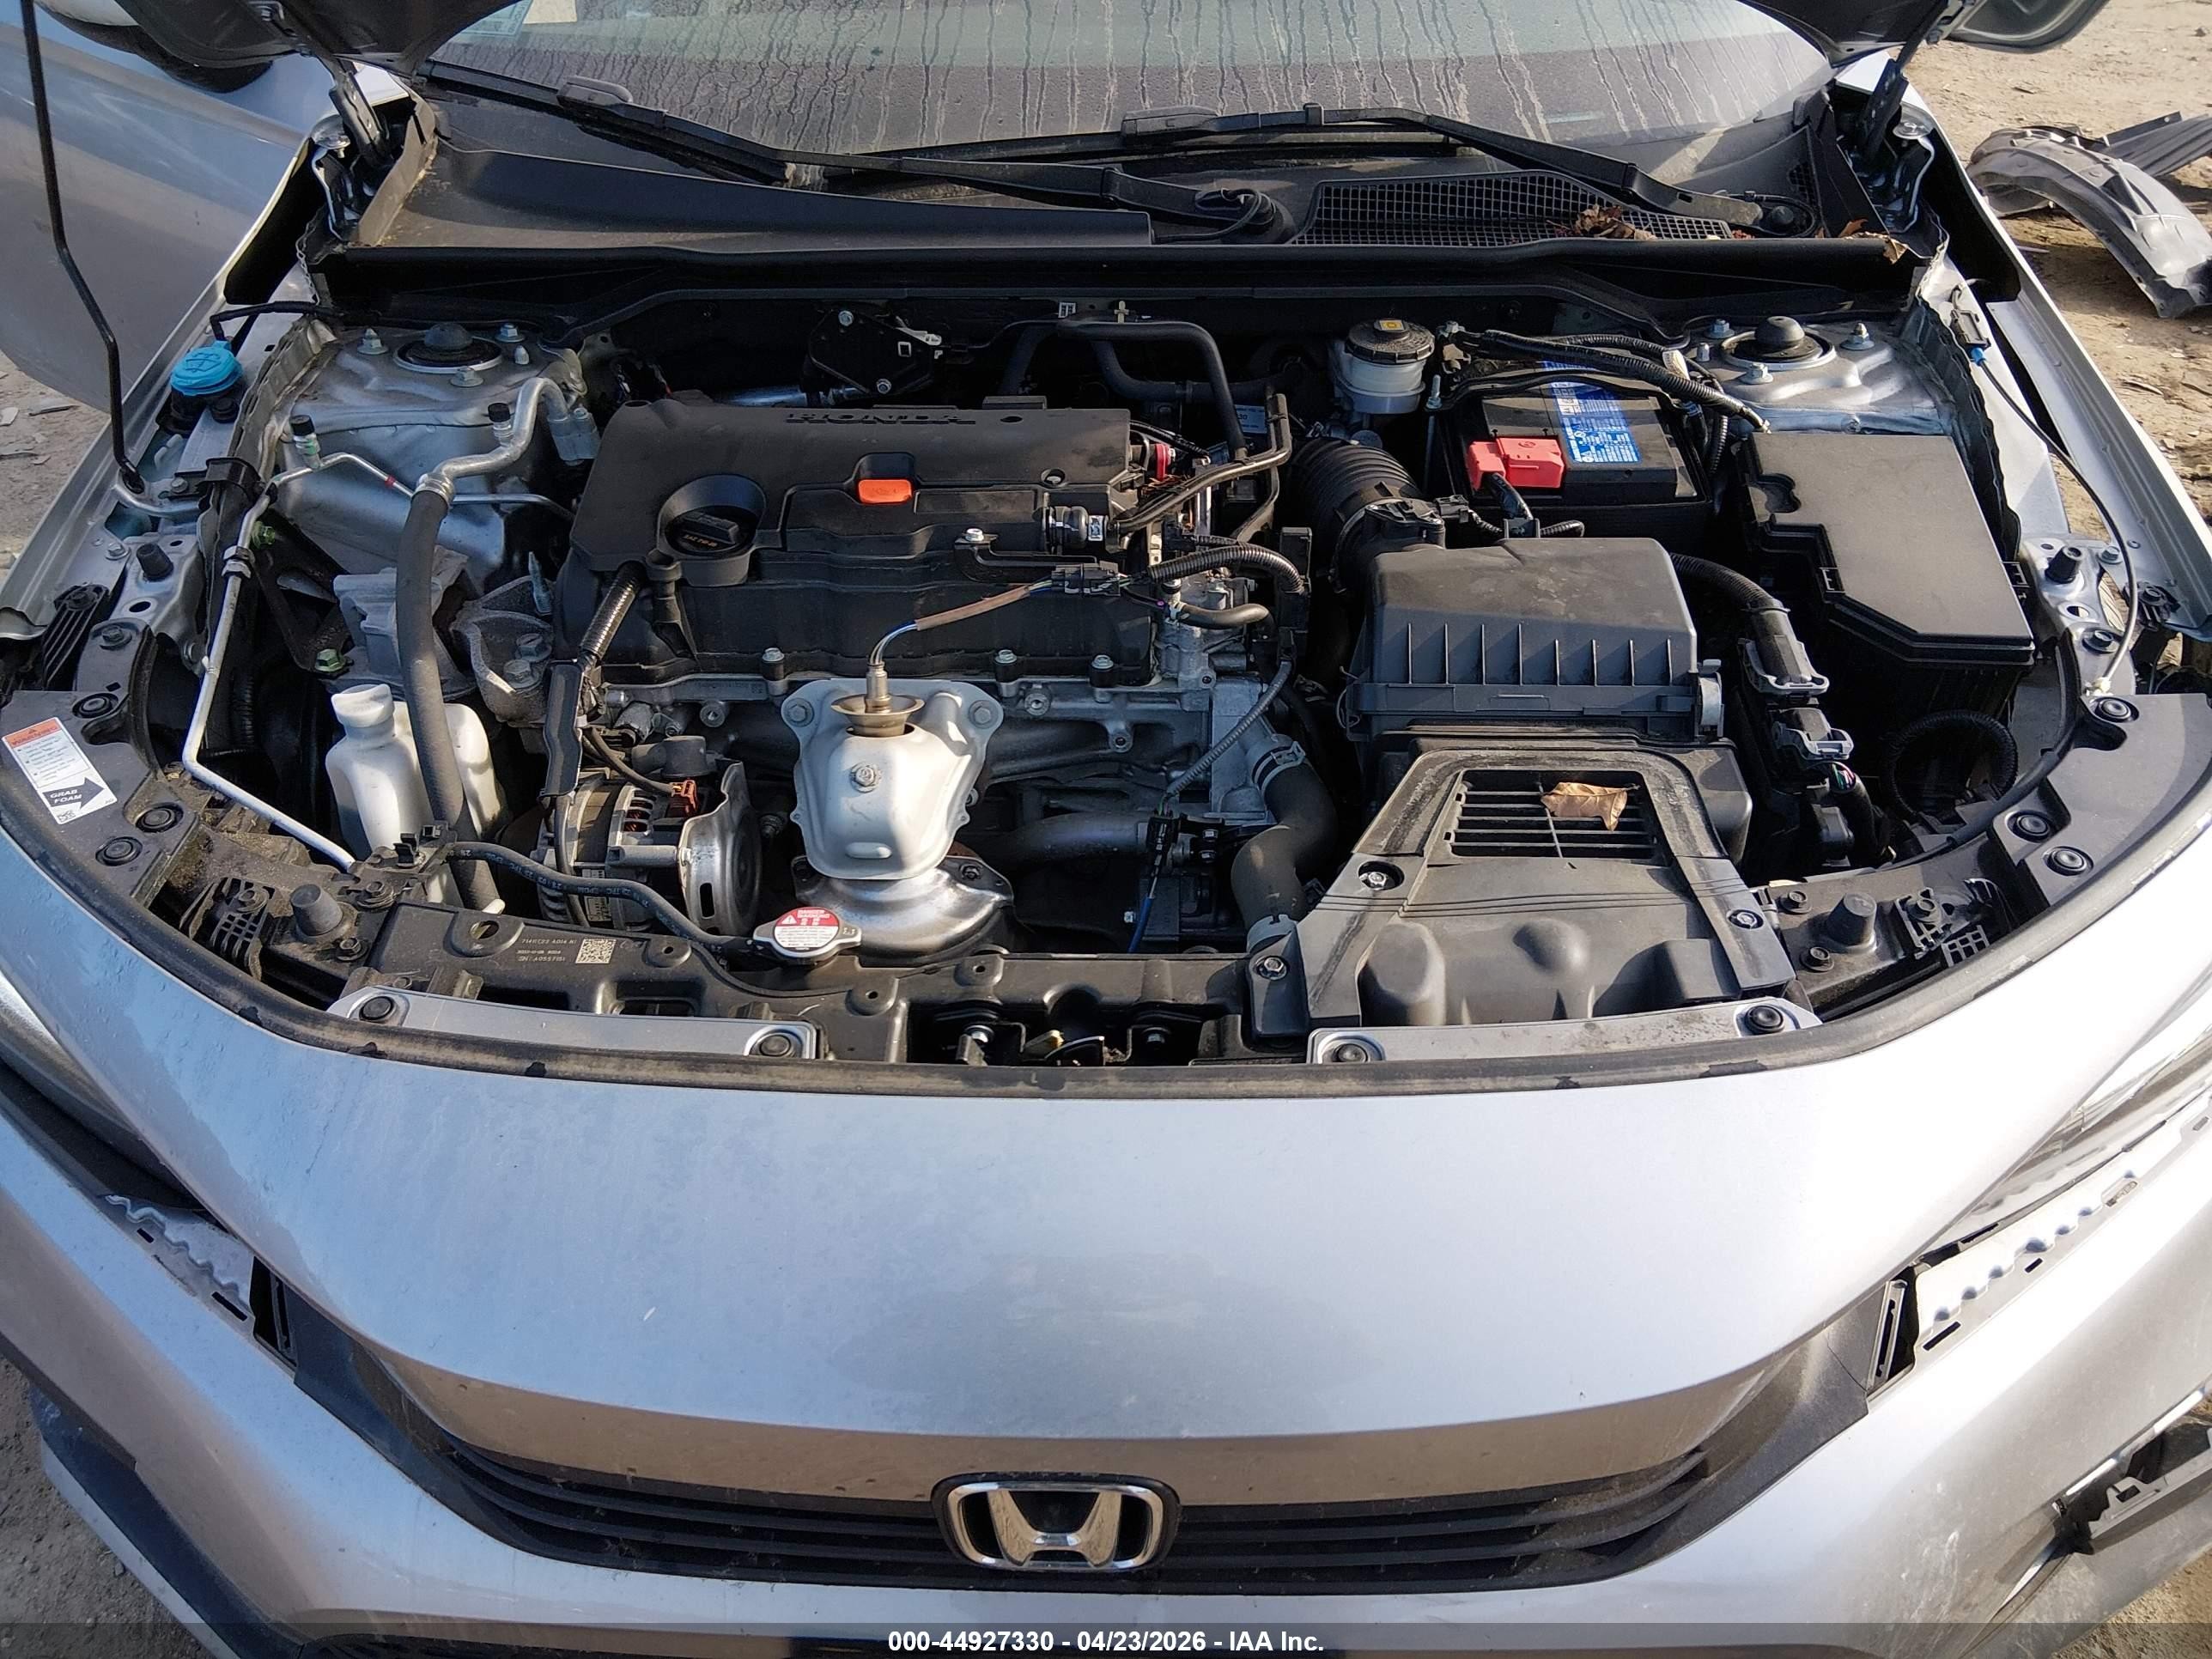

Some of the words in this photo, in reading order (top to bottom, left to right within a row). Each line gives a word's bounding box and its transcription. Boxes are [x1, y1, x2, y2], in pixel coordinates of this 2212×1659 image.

[785, 413, 976, 425] HONDA
[50, 789, 78, 799] GRAB
[54, 793, 82, 804] FOAM
